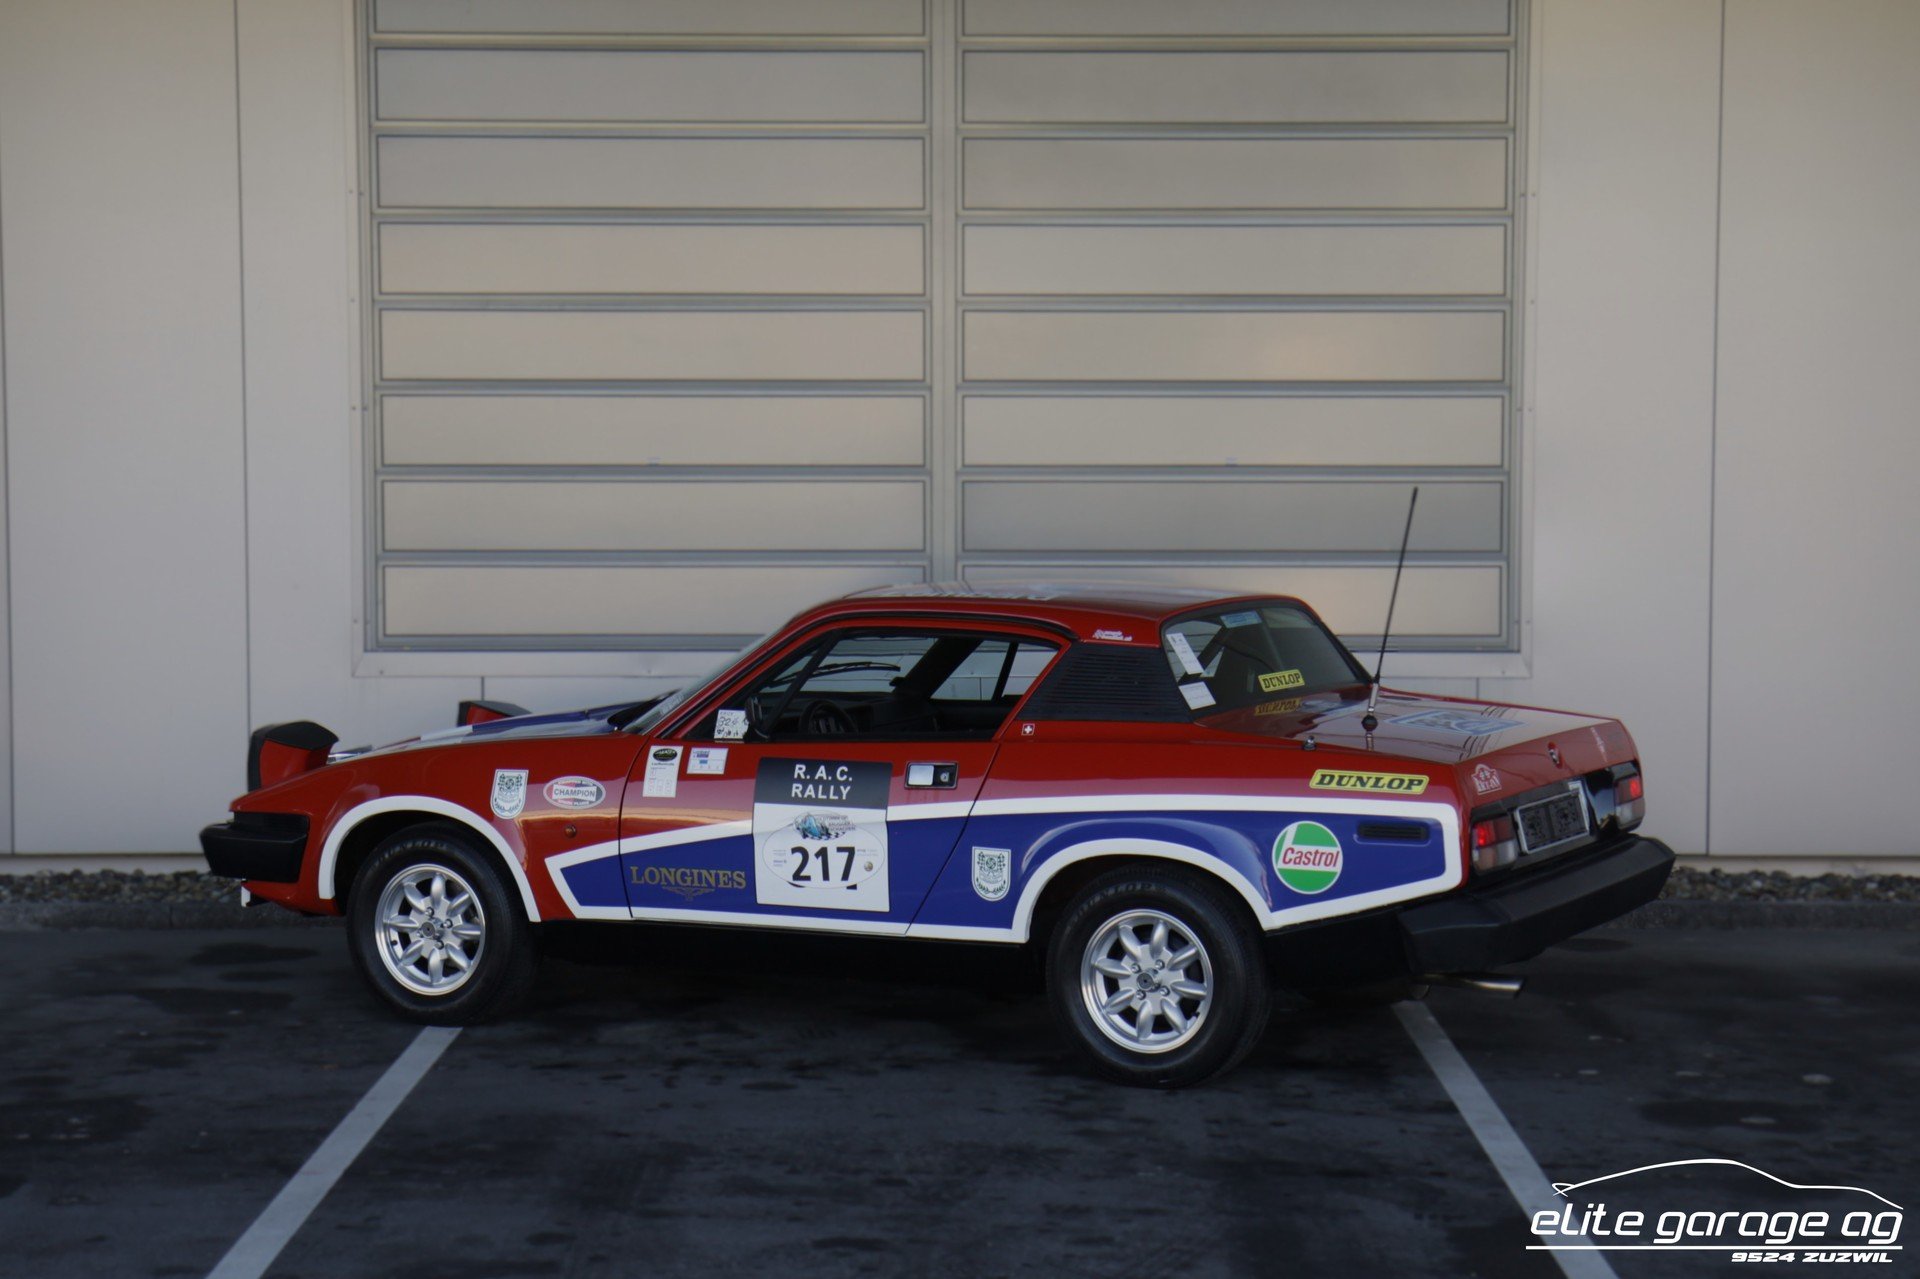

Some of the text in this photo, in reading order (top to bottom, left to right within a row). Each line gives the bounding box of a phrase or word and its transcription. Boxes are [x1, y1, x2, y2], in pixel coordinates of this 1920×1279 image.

[1262, 673, 1301, 689] DUNLOP
[1315, 774, 1424, 791] DUNLOP
[553, 788, 596, 798] CHAMPION
[791, 783, 851, 800] RALLY
[790, 845, 856, 882] 217
[1282, 847, 1340, 868] Castrol
[630, 866, 746, 889] LONGINES
